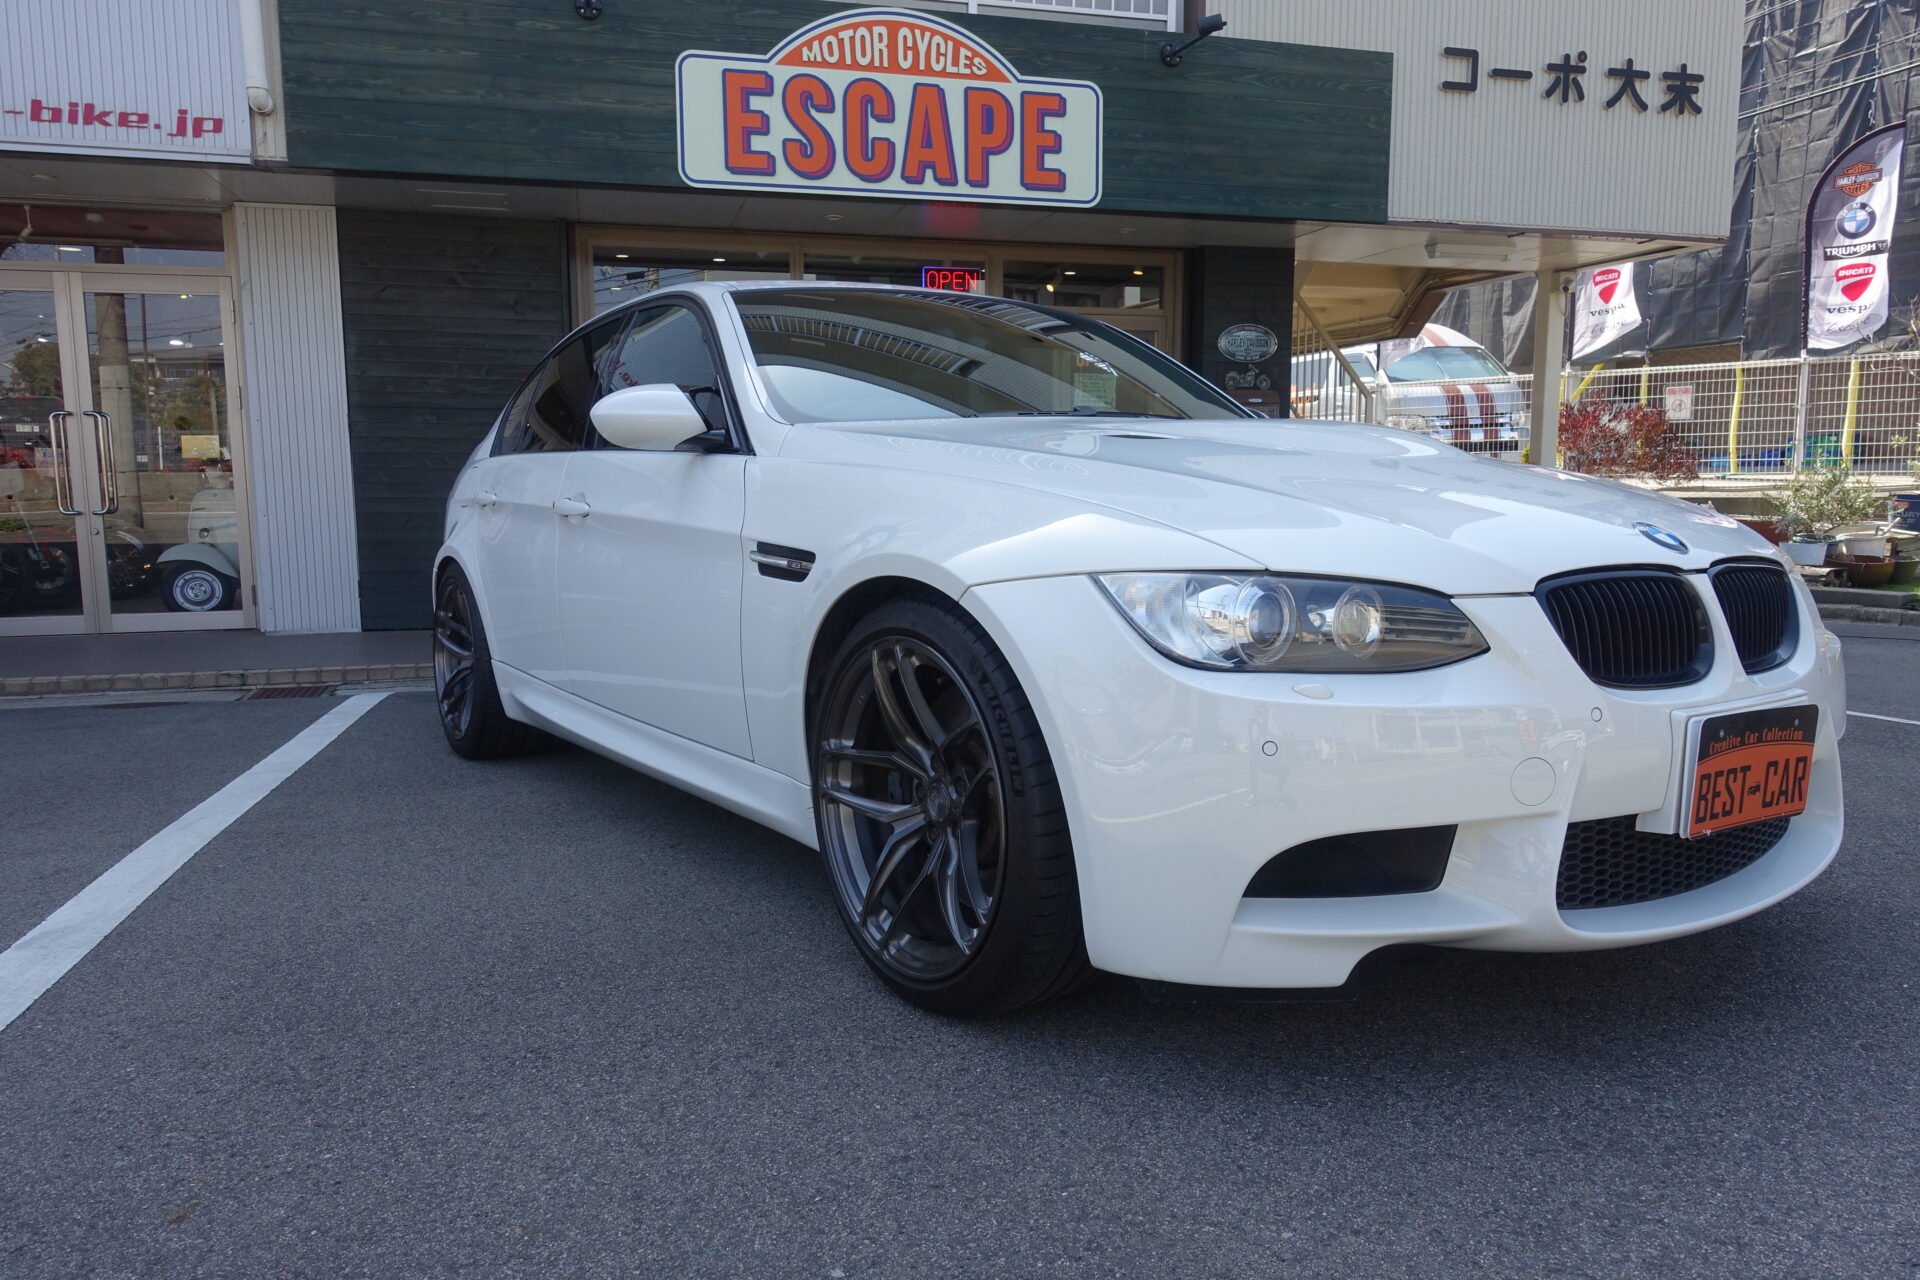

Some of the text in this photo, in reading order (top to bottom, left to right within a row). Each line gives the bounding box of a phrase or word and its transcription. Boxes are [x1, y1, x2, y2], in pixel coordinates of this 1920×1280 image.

[802, 26, 988, 76] MOTOR CYCLES
[722, 68, 1067, 192] ESCAPE
[1825, 242, 1876, 257] TRIUMPH
[926, 271, 978, 292] OPEN
[1595, 272, 1619, 282] DUCATI
[1838, 266, 1873, 277] DUCATI
[1709, 727, 1804, 755] Creative Car Collection
